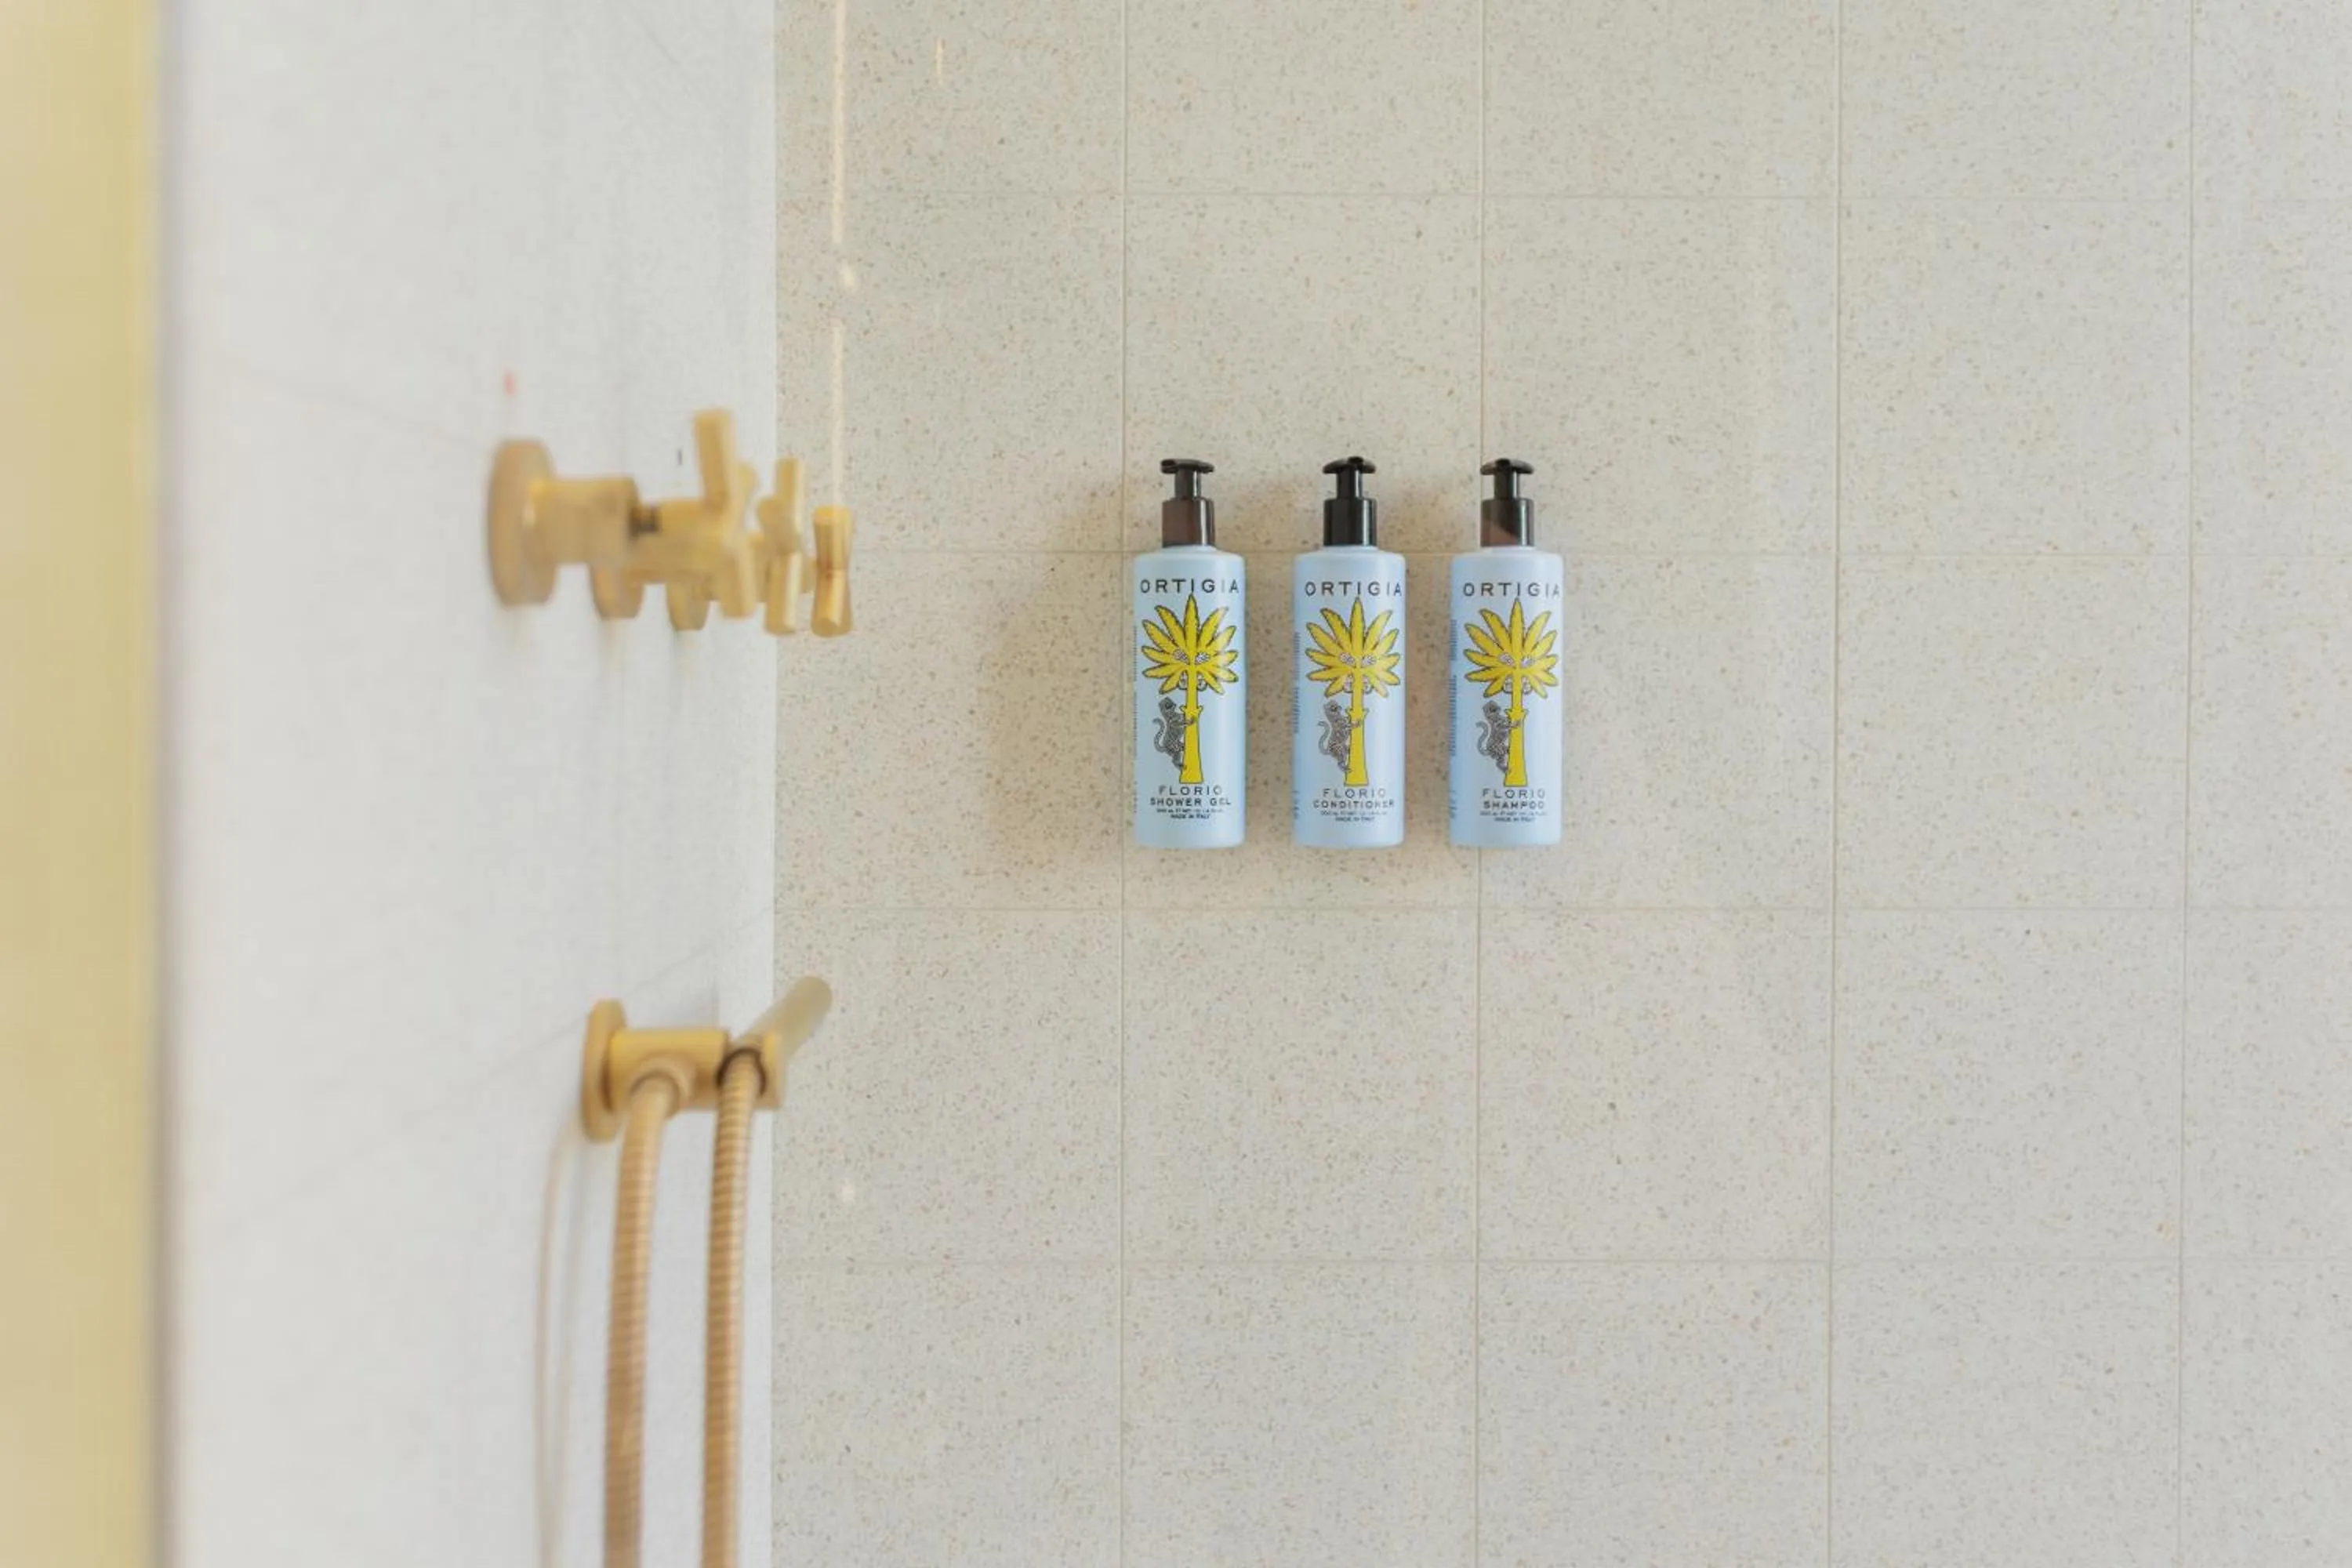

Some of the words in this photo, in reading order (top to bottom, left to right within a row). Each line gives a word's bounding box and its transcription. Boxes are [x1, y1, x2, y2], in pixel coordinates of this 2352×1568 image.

[1140, 579, 1240, 593] ORTIGIA
[1304, 581, 1403, 597] ORTIGIA
[1463, 582, 1561, 597] ORTIGIA
[1158, 786, 1223, 796] FLORIO
[1323, 788, 1386, 798] FLORIO
[1482, 788, 1546, 799] FLORIO
[1150, 797, 1202, 807] SHOWER
[1210, 797, 1231, 806] GEL
[1313, 800, 1395, 809] CONDITIONER
[1483, 800, 1544, 809] SHAMPOO
